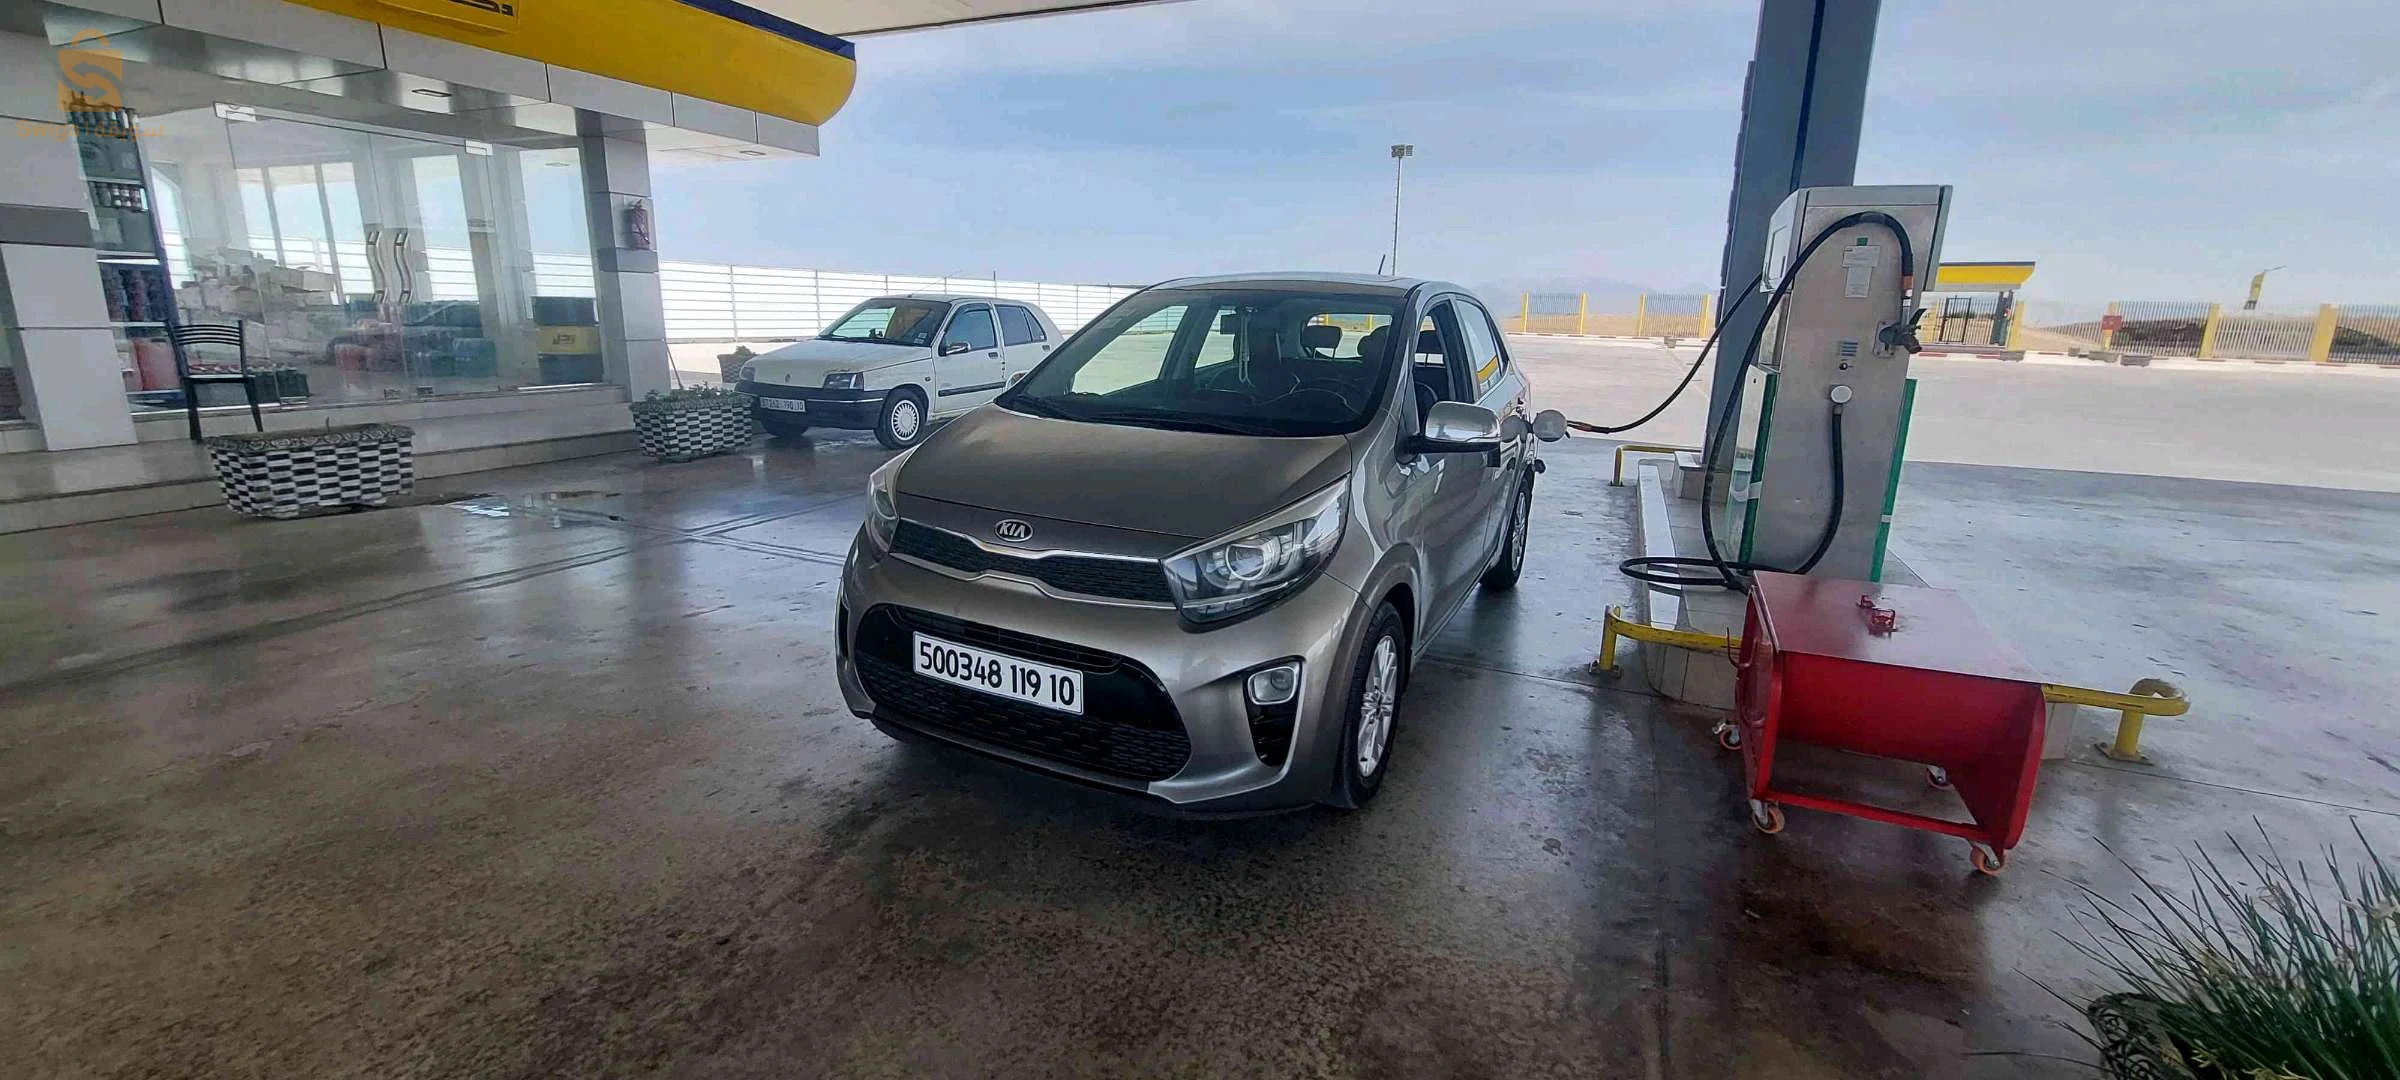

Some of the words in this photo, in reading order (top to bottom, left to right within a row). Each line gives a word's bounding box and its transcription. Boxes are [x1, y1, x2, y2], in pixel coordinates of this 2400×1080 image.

[1000, 522, 1025, 538] KIA
[920, 642, 1002, 688] 500348
[1010, 664, 1041, 697] 119
[1049, 673, 1074, 706] 10
